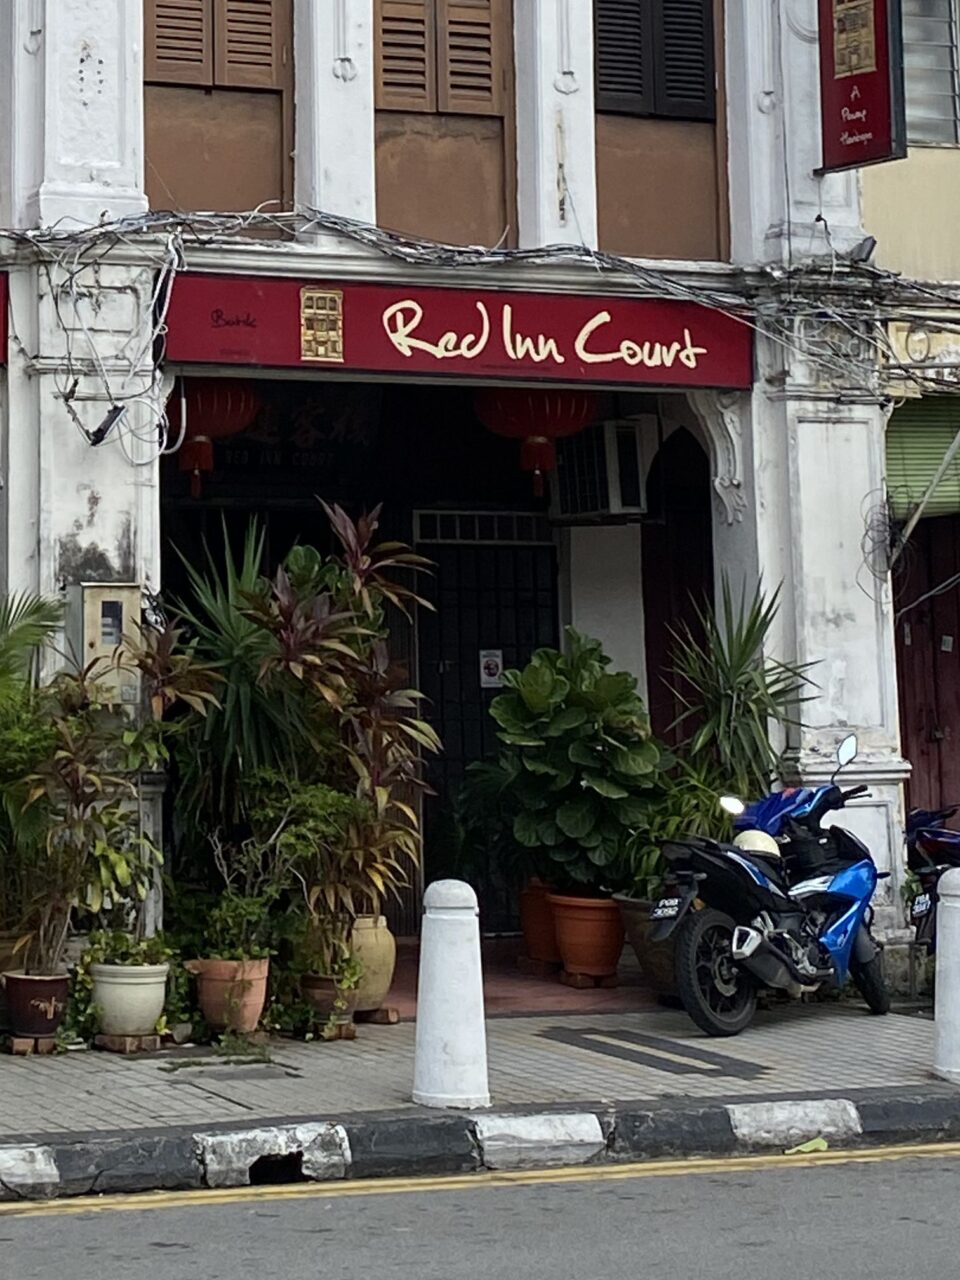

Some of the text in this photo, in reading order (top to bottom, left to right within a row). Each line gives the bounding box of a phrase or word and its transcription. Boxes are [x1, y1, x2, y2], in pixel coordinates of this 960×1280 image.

[851, 85, 861, 101] A
[383, 300, 707, 368] Red Inn Court
